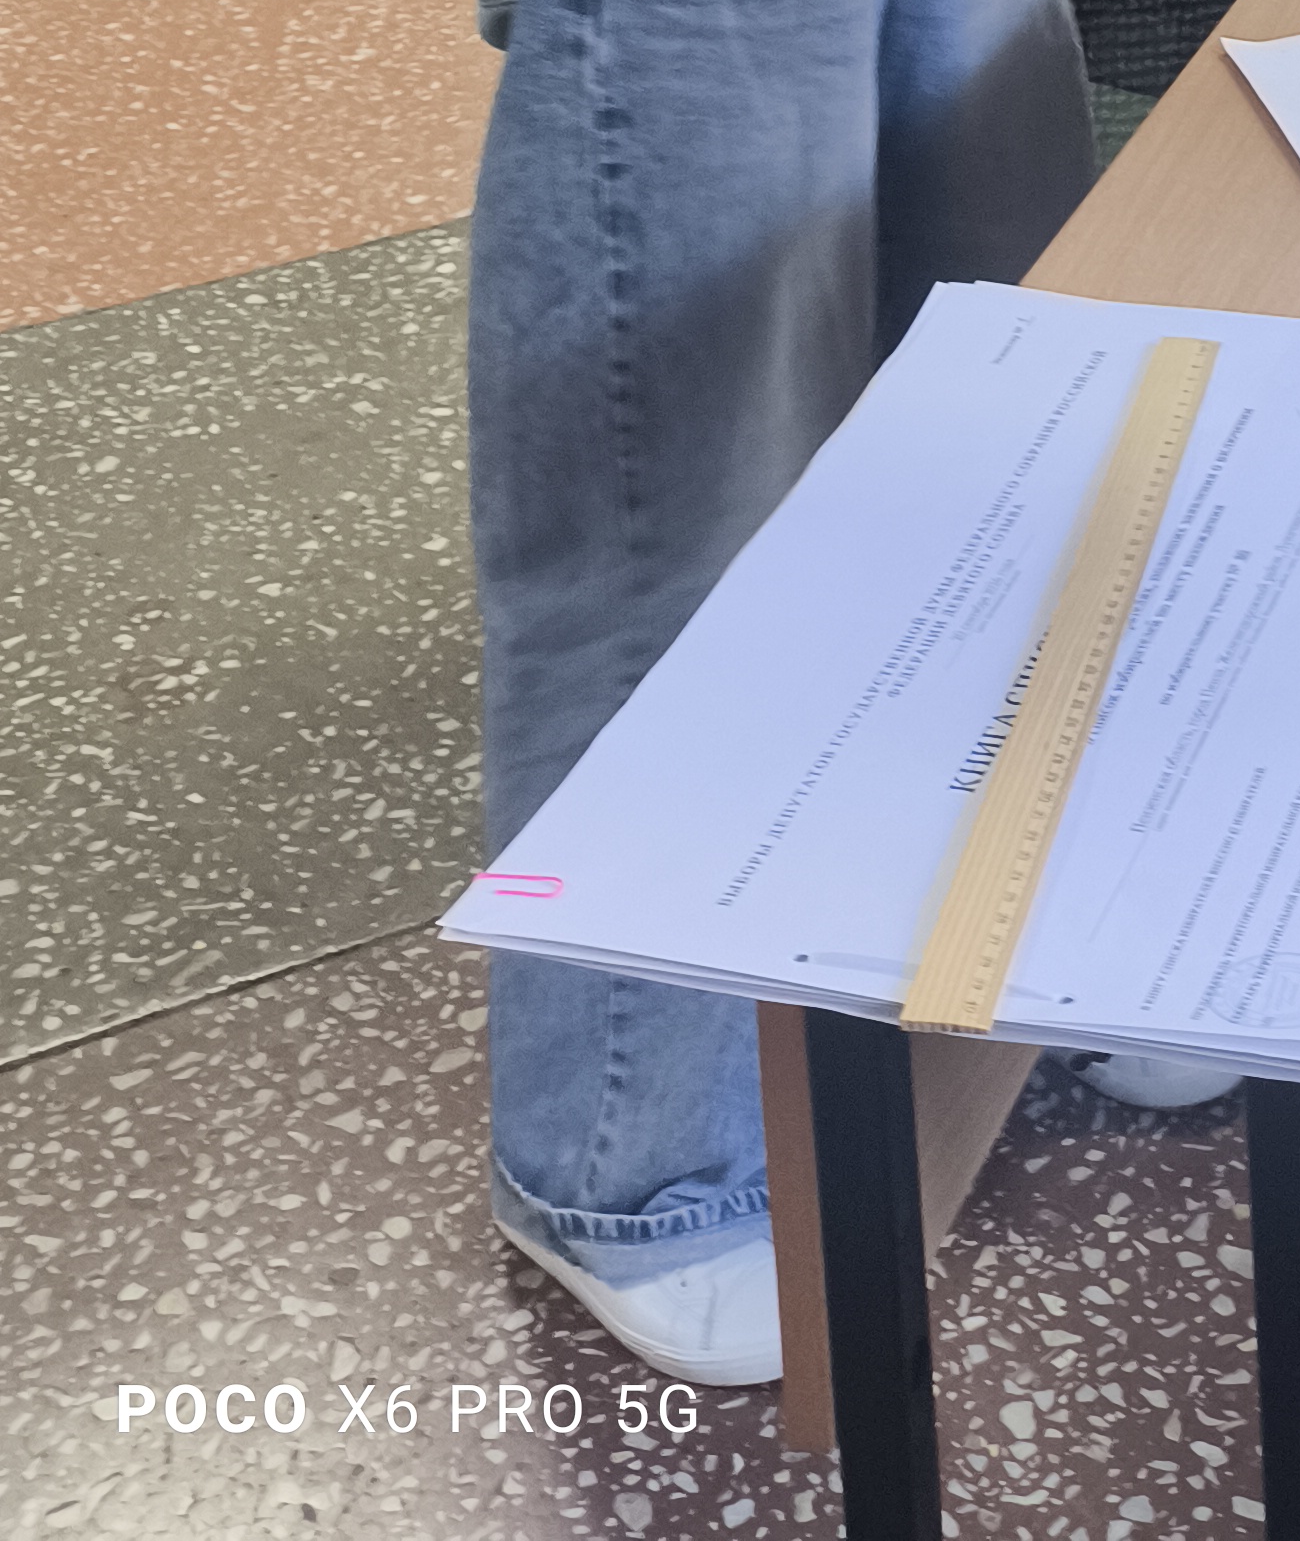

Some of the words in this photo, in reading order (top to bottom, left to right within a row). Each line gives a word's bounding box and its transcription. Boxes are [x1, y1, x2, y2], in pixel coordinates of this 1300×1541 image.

[715, 842, 774, 907] ВЫБОРЫ
[766, 749, 836, 840] ДЕПУТАТОВ
[827, 616, 929, 747] ГОСУДАРСТВЕННОЙ
[921, 575, 957, 615] ДУМЫ
[948, 479, 1020, 573] ФЕДЕРАЛЬНОГО
[1011, 417, 1060, 478] СОБРАНИЯ
[1050, 349, 1108, 416] РОССИЙСКОЙ
[885, 619, 949, 698] ФЕДЕРАЦИИ
[940, 552, 993, 618] ДЕВЯТОГО
[984, 503, 1026, 550] СОЗЫВА
[948, 713, 1018, 793] КНИГА
